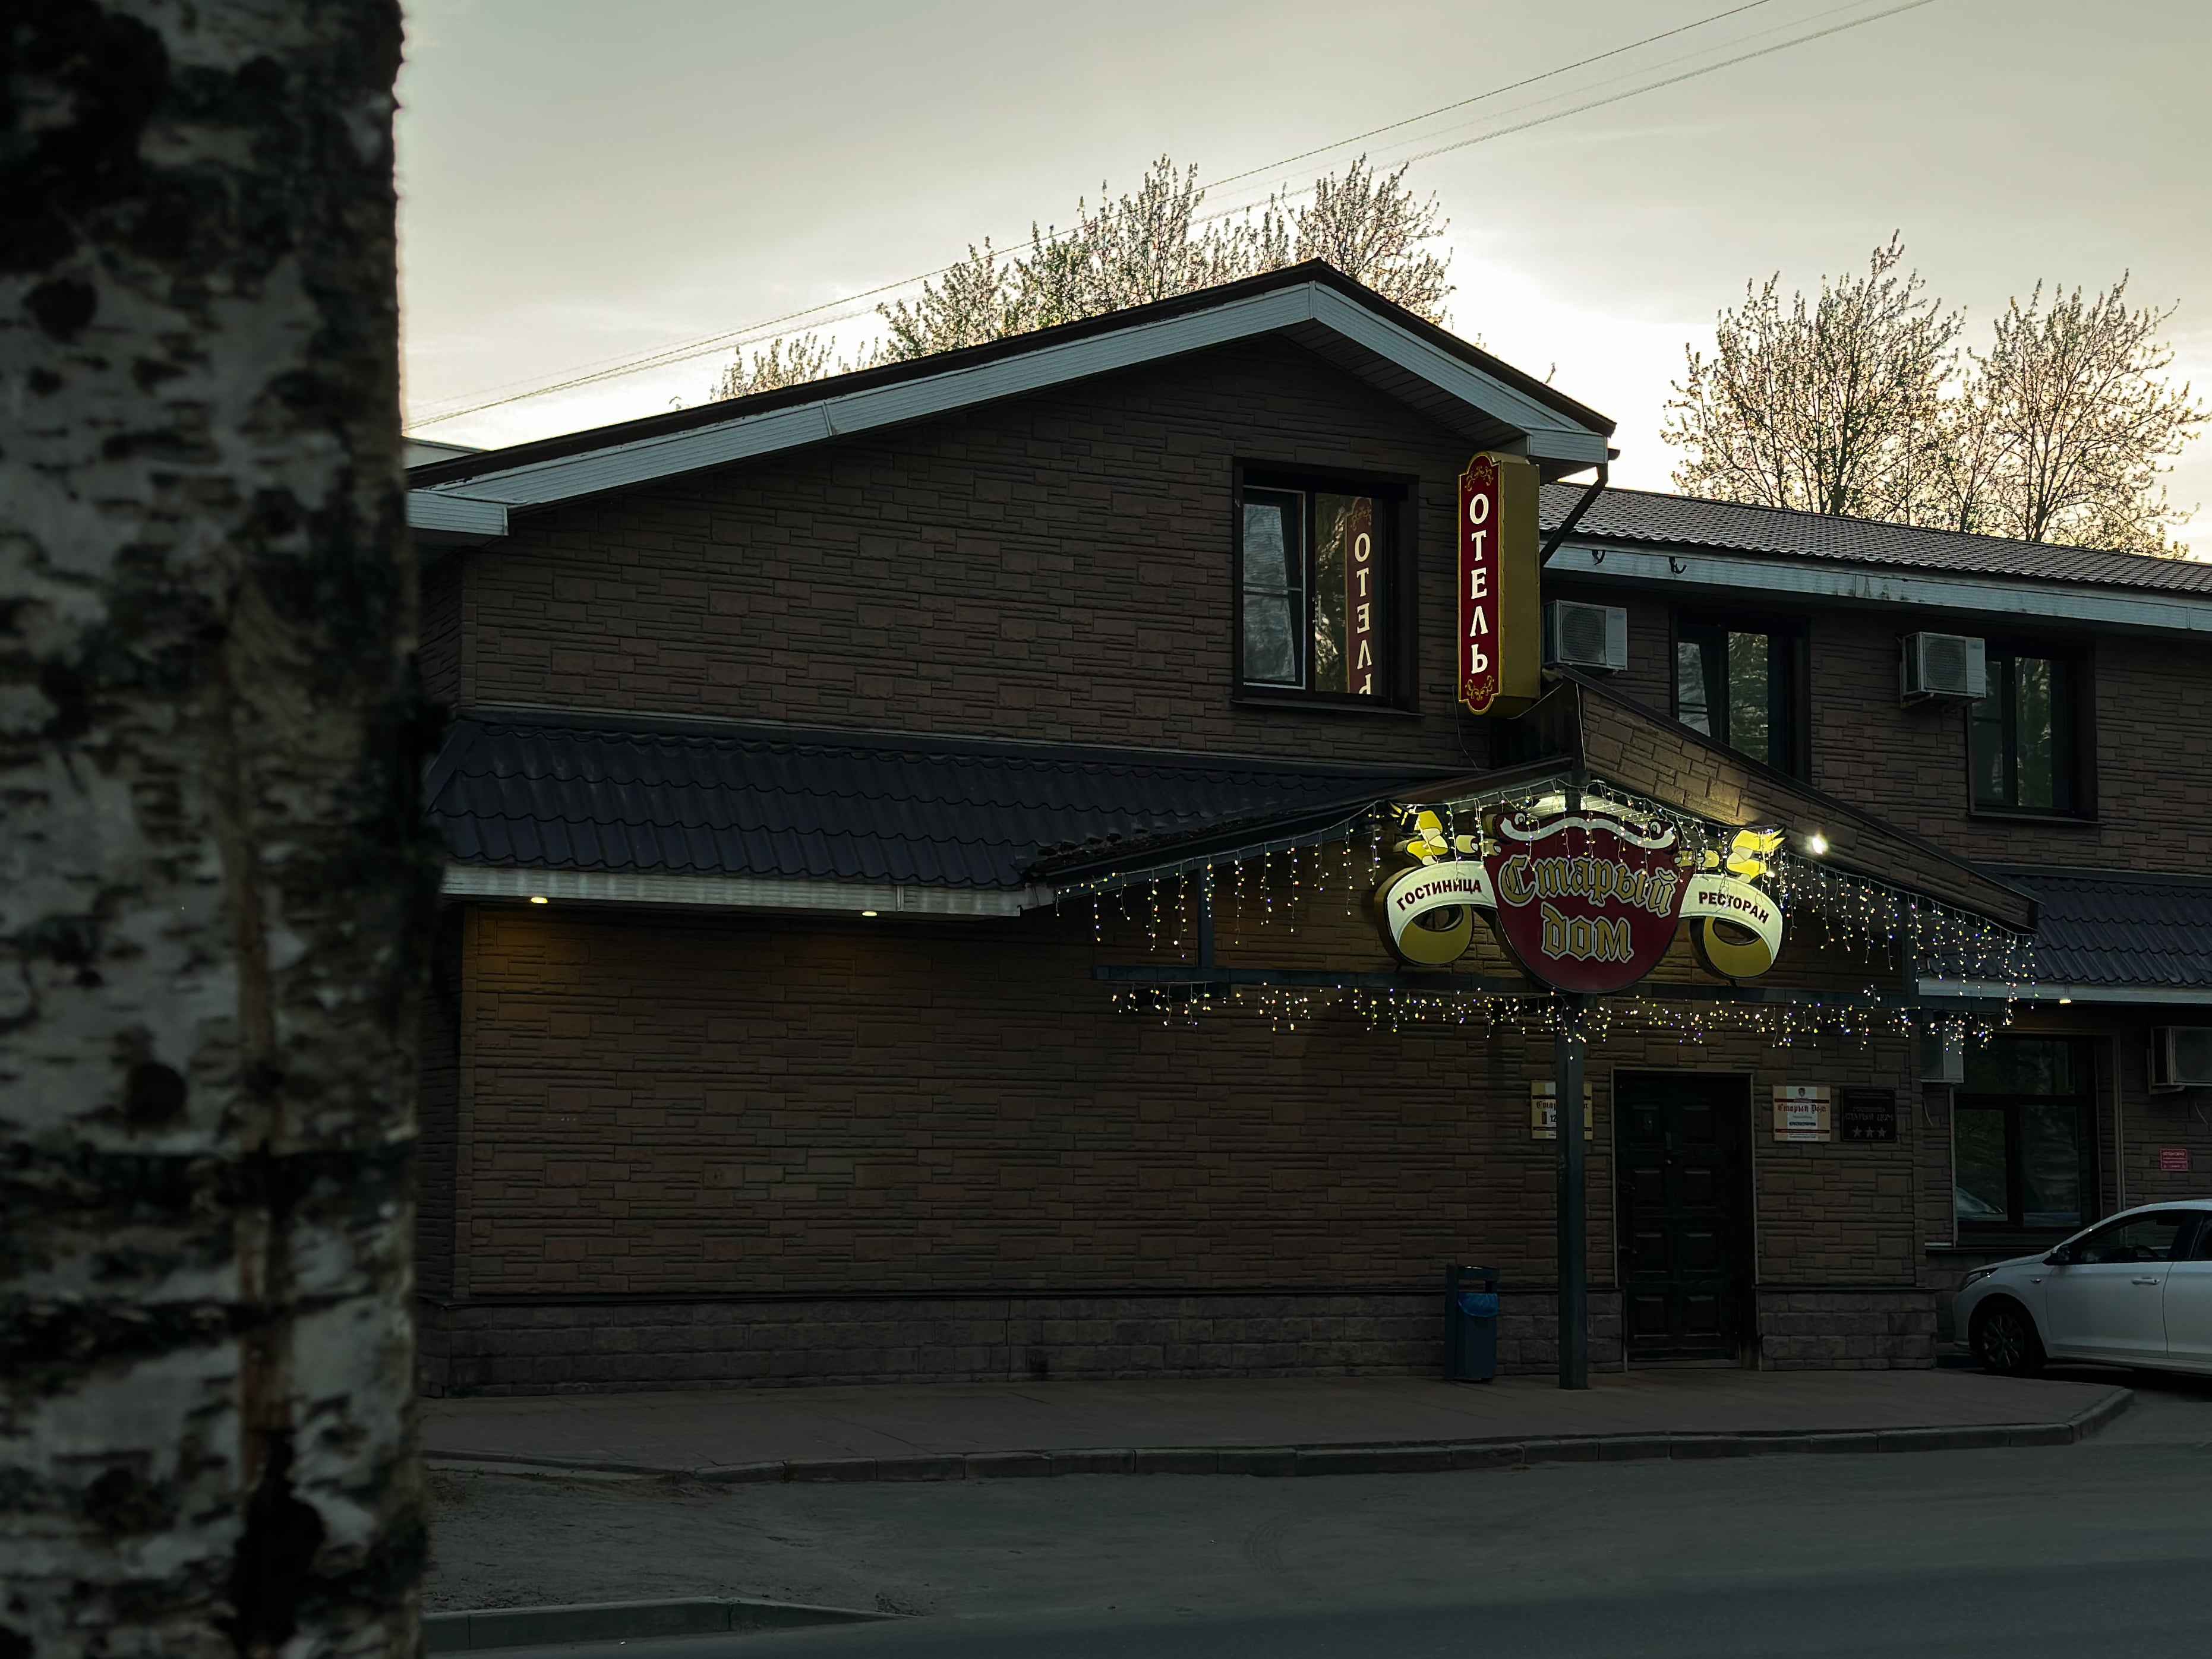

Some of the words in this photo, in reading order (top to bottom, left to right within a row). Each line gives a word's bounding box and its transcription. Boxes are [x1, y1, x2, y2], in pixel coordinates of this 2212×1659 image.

[1469, 493, 1489, 675] ОТЕЛЬ
[1396, 879, 1482, 912] ГОСТИНИЦА
[1498, 855, 1678, 918] Старый
[1699, 891, 1769, 924] РЕСТОРАН
